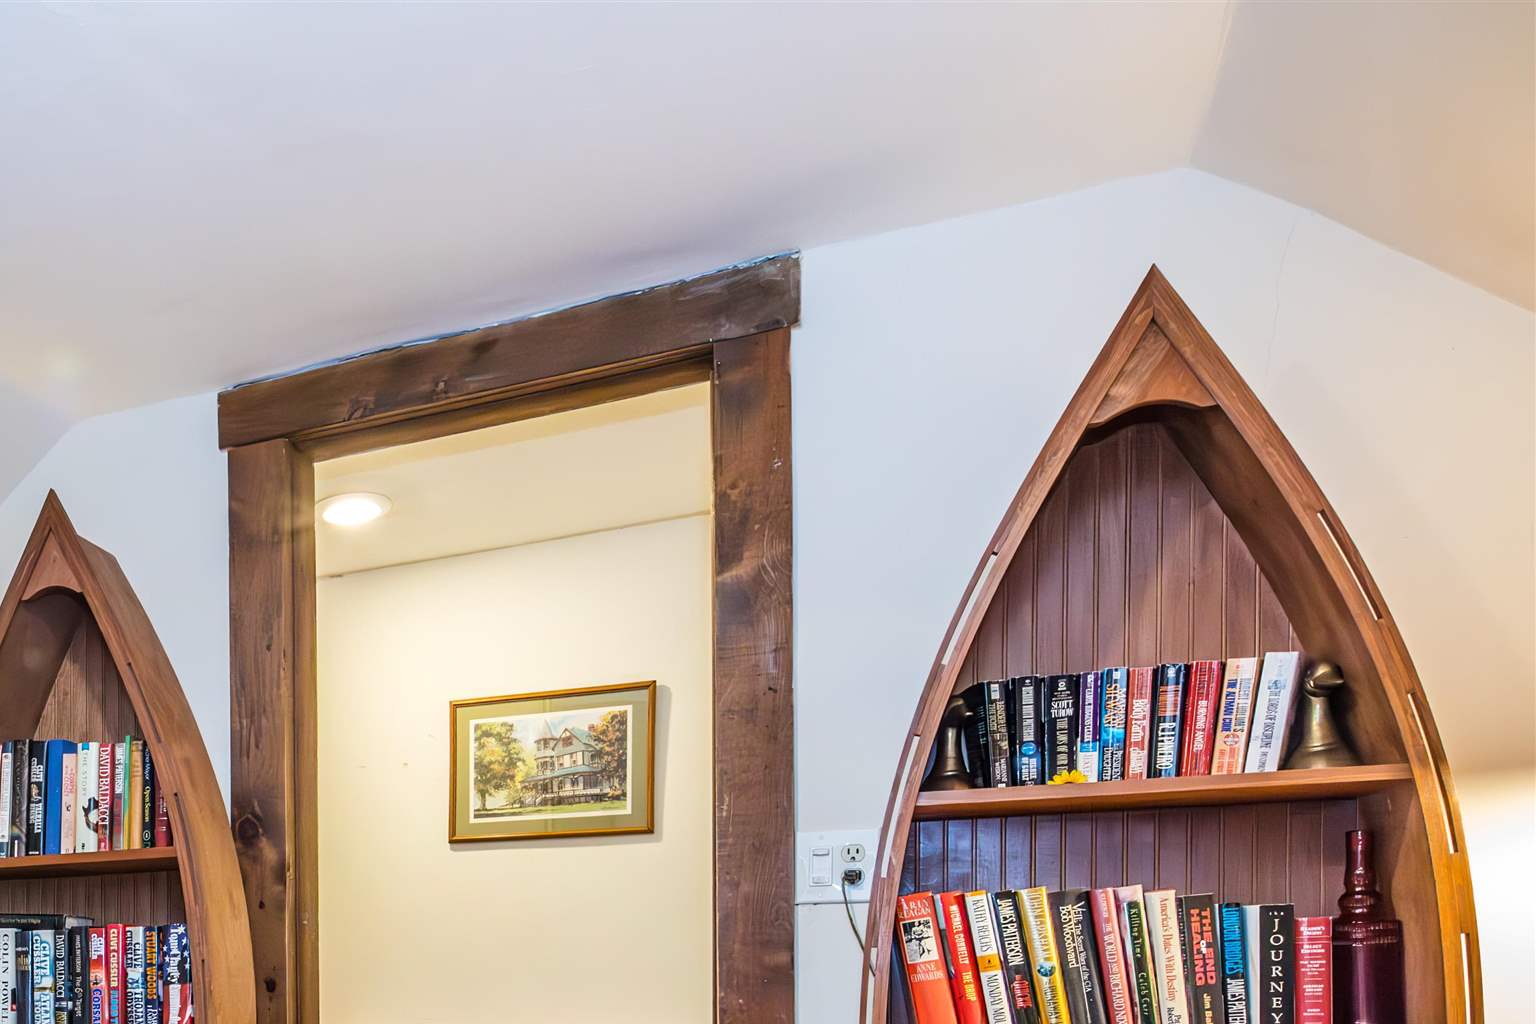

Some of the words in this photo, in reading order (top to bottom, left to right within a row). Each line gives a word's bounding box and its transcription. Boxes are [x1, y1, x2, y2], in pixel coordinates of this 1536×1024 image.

[1227, 679, 1238, 689] THE
[1051, 708, 1073, 718] TUROW
[1052, 700, 1073, 709] SCOTT
[1104, 684, 1118, 727] STEWART
[1130, 700, 1147, 718] Body
[1195, 700, 1207, 729] BURNING
[1224, 691, 1236, 715] ALTMAN
[1057, 719, 1068, 729] THE
[1131, 719, 1146, 741] Farm
[1221, 717, 1233, 733] CODE
[1057, 731, 1068, 744] LAWS
[1193, 730, 1204, 752] ANGEL
[99, 747, 109, 776] DAVID
[1057, 754, 1068, 765] OUR
[98, 779, 109, 824] BALDACCI
[950, 905, 963, 931] MICHAEL
[973, 899, 986, 920] KATHY
[997, 899, 1015, 924] JAMES
[1060, 906, 1072, 922] Bob
[1160, 897, 1172, 932] America's
[1223, 907, 1239, 940] LONDON
[56, 935, 65, 958] DAVID
[146, 931, 155, 964] STUART
[168, 928, 180, 948] Tom
[954, 934, 969, 964] CONNELLY
[977, 922, 993, 952] REICHS
[1002, 925, 1024, 965] PATTERSON
[1062, 923, 1078, 968] Woodward
[1163, 935, 1173, 954] Dates
[1190, 909, 1204, 986] HEALING
[1200, 940, 1206, 954] OF
[1201, 909, 1212, 942] THE
[1207, 949, 1216, 984] END
[41, 943, 50, 976] CLIVE
[134, 942, 142, 968] CLIVE
[1130, 909, 1141, 936] Killing
[1139, 972, 1148, 994] Caleb
[1166, 956, 1175, 973] With
[1224, 942, 1243, 974] BRIDGES
[168, 948, 180, 984] Clancy
[916, 963, 936, 971] ANNE
[962, 972, 972, 982] THE
[1104, 934, 1116, 962] WORLD
[1111, 975, 1124, 1011] RICHARD
[1270, 918, 1284, 1024] JOURNEY
[56, 961, 65, 998] BALDACCI
[146, 967, 156, 999] WOODS
[986, 975, 1004, 1007] MONDAY
[1165, 975, 1177, 1001] Destiny
[1227, 978, 1245, 1001] JAMES
[965, 985, 976, 1001] DROP
[1174, 1015, 1182, 1024] Pat
